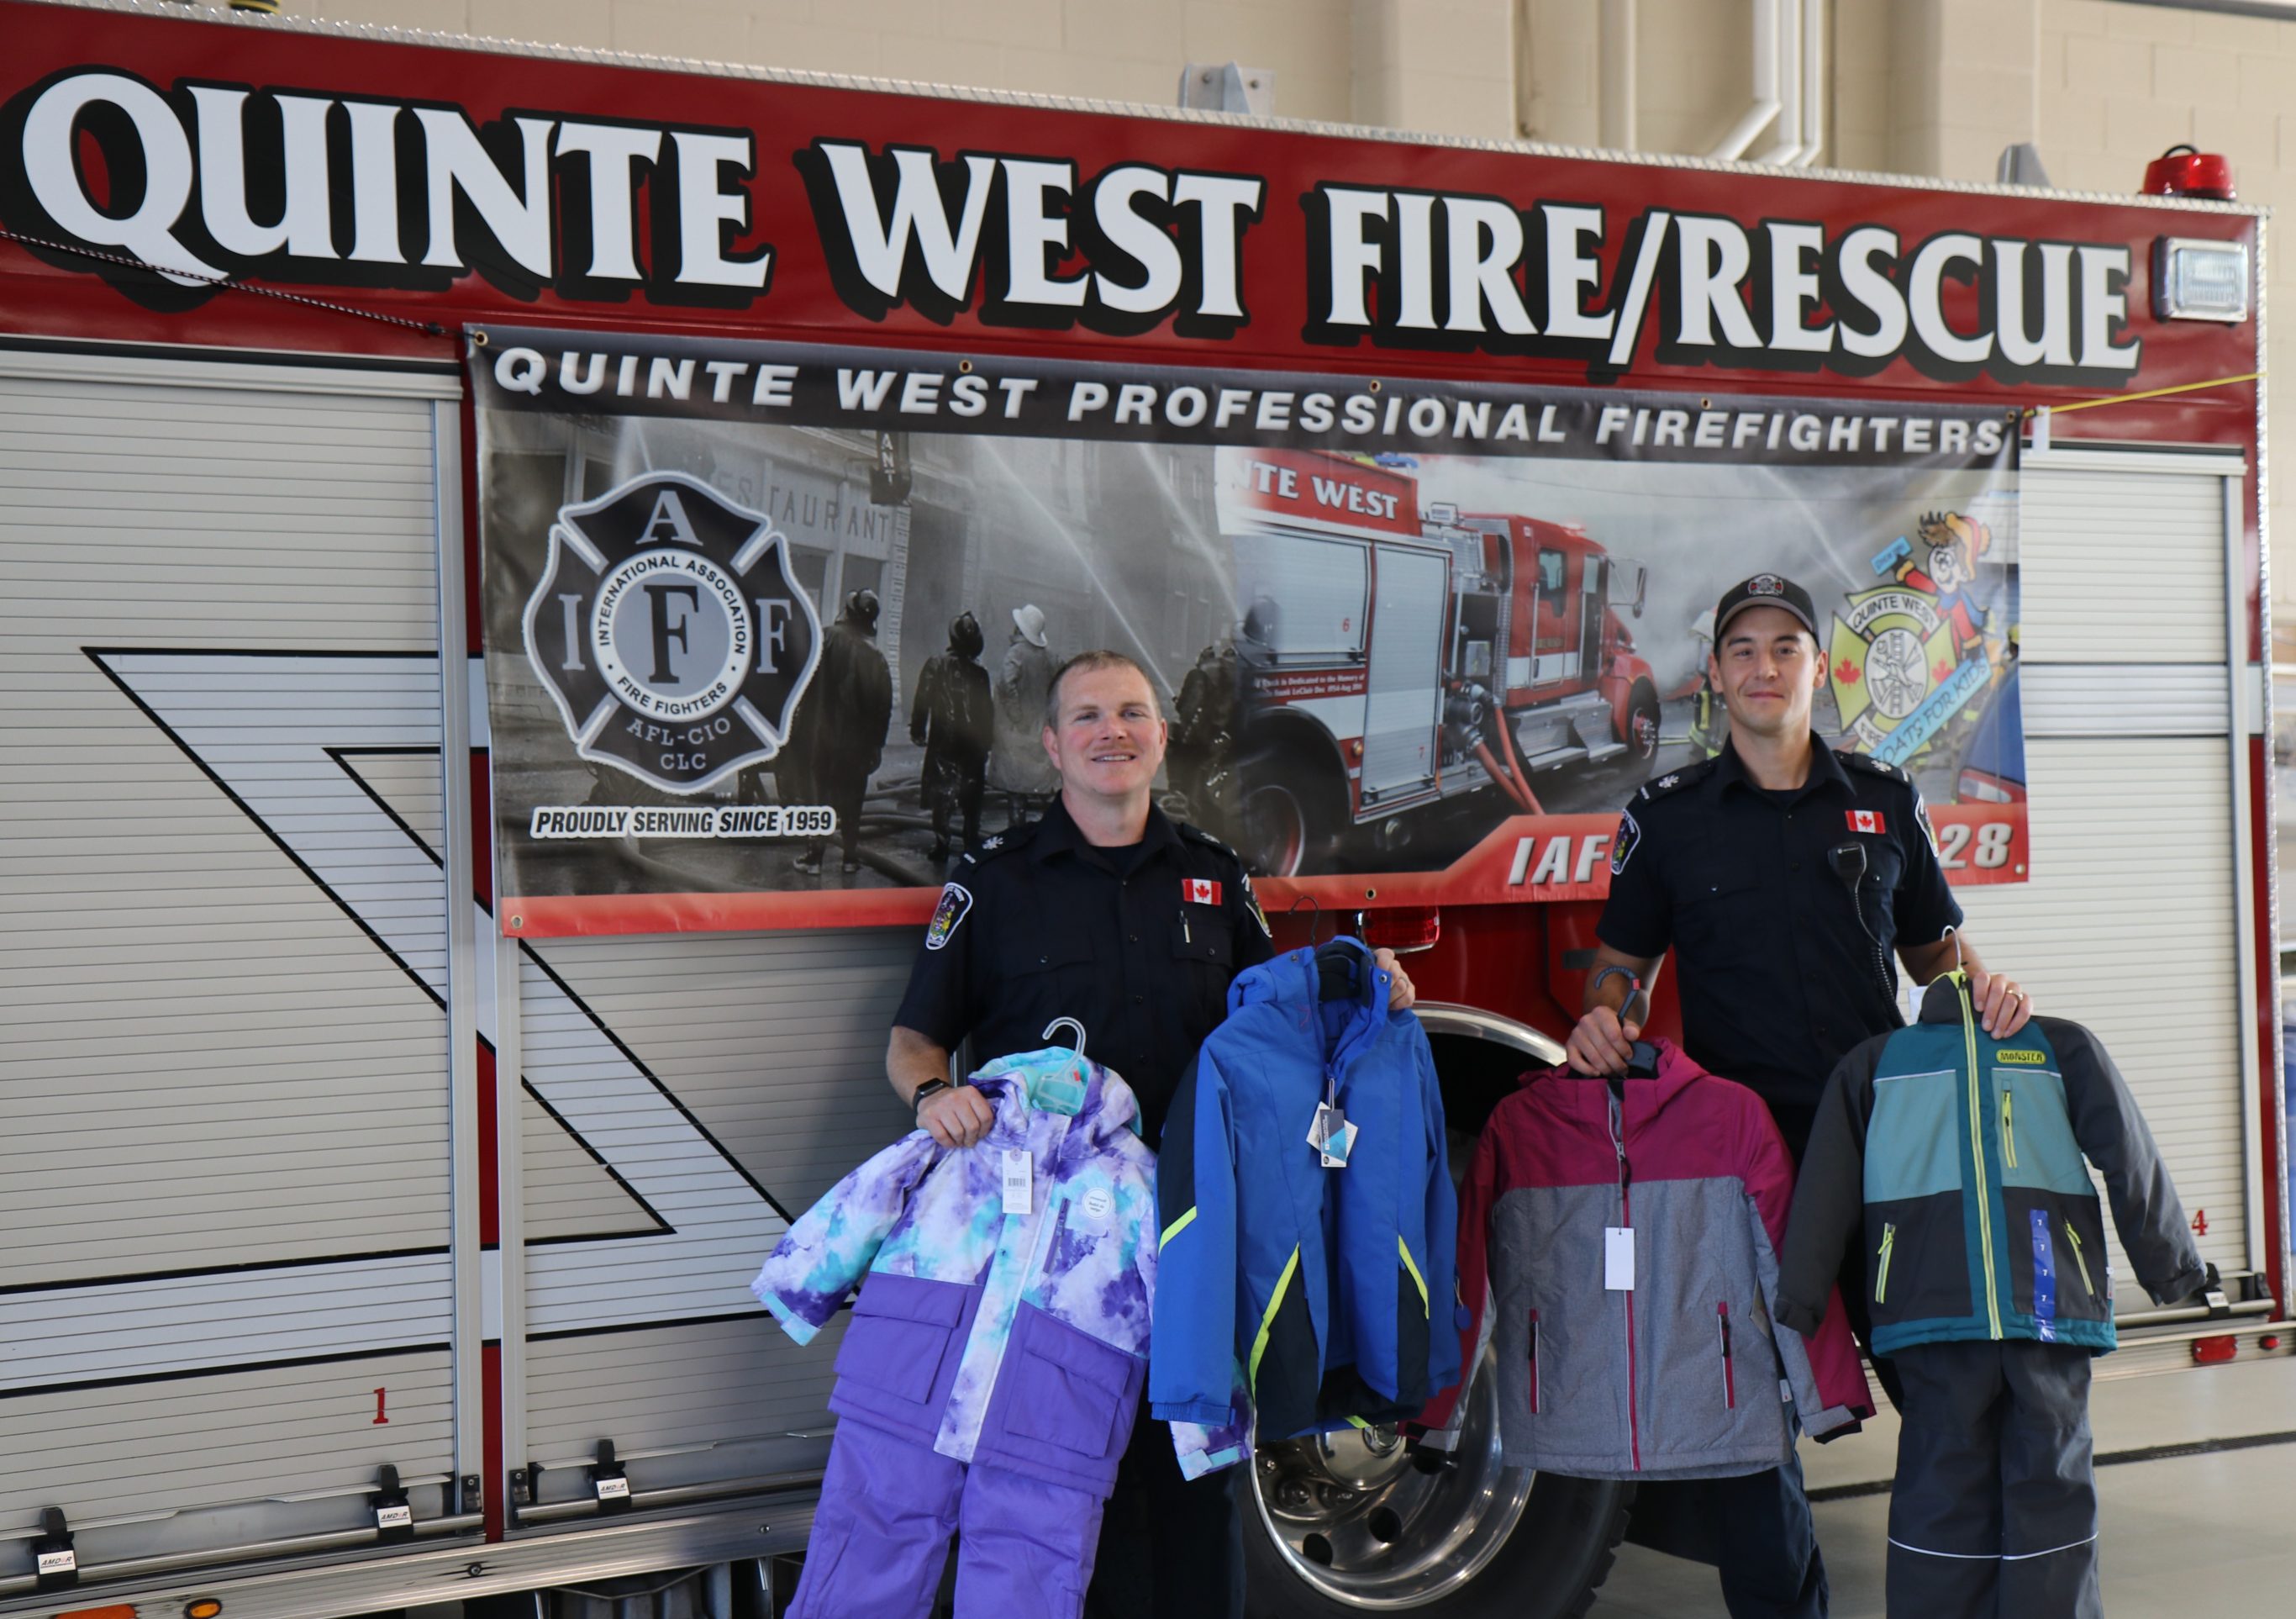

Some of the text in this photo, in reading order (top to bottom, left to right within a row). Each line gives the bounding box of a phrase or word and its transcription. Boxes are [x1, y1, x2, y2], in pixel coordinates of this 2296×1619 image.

[22, 72, 2141, 371] QUINTE WEST FIRE/RESCUE
[495, 345, 2004, 456] QUINTE WEST PROFESSIONAL FIREFIGHTERS
[635, 489, 704, 546] A
[1311, 476, 1398, 519] WEST
[598, 556, 746, 655] INTERNATIONAL ASSOCIATION
[1852, 595, 1935, 629] QUINTE WEST
[558, 593, 586, 671] I
[643, 584, 700, 684] F
[755, 598, 793, 674] F
[618, 676, 728, 715] FIRE FIGHTERS
[1877, 659, 1989, 764] OATS FOR KIDS
[626, 717, 732, 746] AFL-CIO
[660, 753, 707, 770] CLC
[535, 810, 832, 833] PROUDLY SERVING SINCE 1959
[1938, 823, 2014, 869] 28
[2190, 1209, 2209, 1237] 4
[373, 1388, 389, 1424] 1
